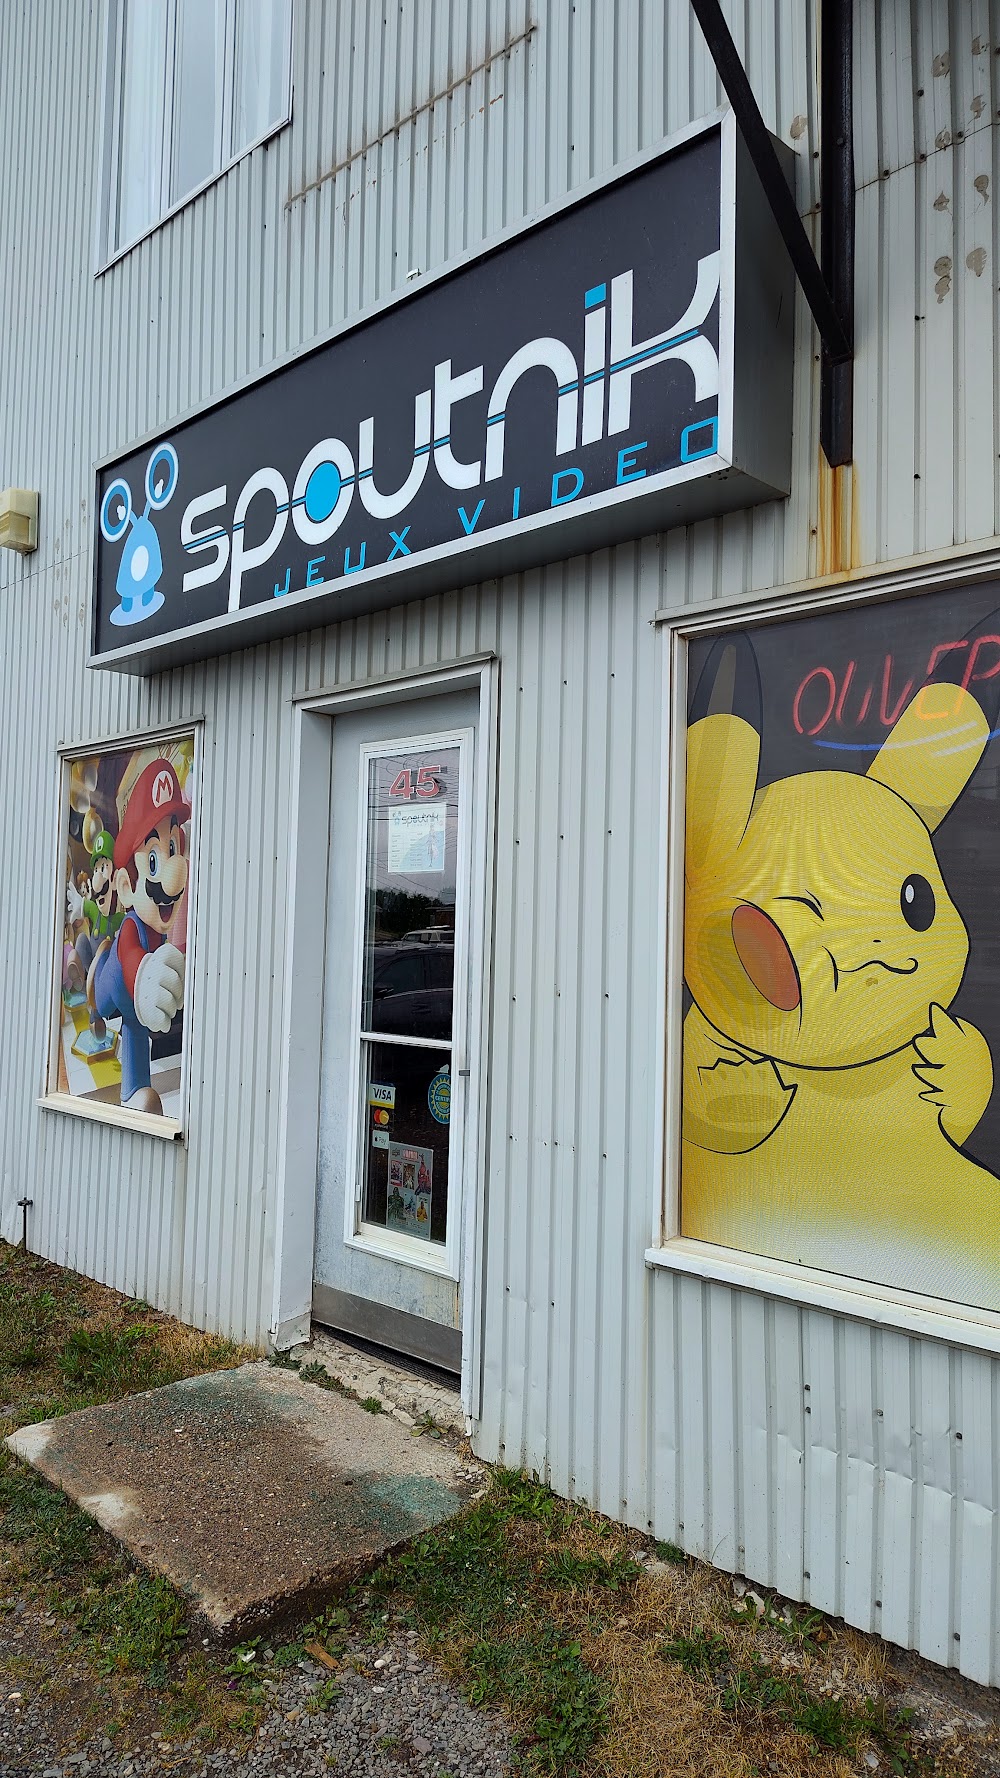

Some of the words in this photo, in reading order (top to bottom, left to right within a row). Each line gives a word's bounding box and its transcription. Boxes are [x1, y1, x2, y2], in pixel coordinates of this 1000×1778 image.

[274, 526, 412, 598] JEUX
[457, 415, 719, 535] VIDEO
[155, 774, 173, 804] M
[388, 765, 441, 800] 45
[372, 1087, 392, 1101] VISA
